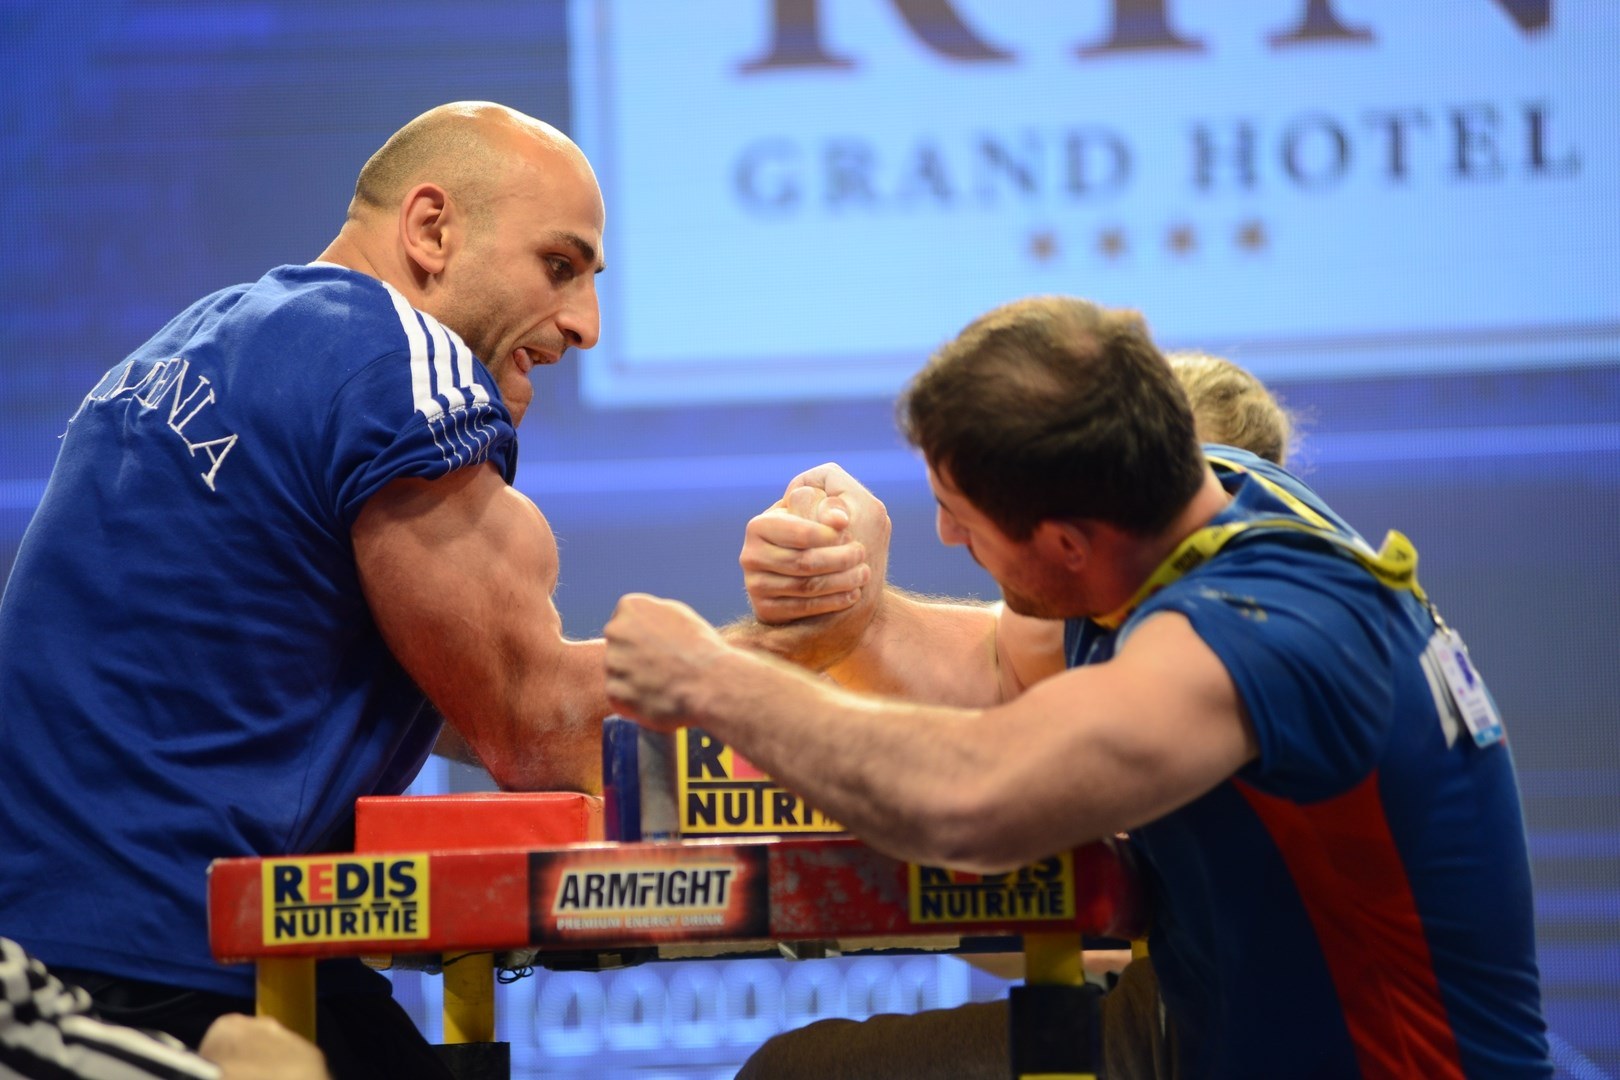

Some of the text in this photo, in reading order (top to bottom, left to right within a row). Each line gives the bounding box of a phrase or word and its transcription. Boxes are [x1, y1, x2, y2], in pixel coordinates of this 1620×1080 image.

[733, 101, 1580, 216] GRAND HOTEL
[687, 783, 839, 826] NUTRI
[273, 861, 417, 903] REDIS
[559, 870, 731, 909] ARMFIGHT
[920, 883, 1063, 918] NUTRITIE
[274, 903, 417, 938] NUTRITIE
[557, 914, 724, 930] PREMIUM ENERGY DRINK
